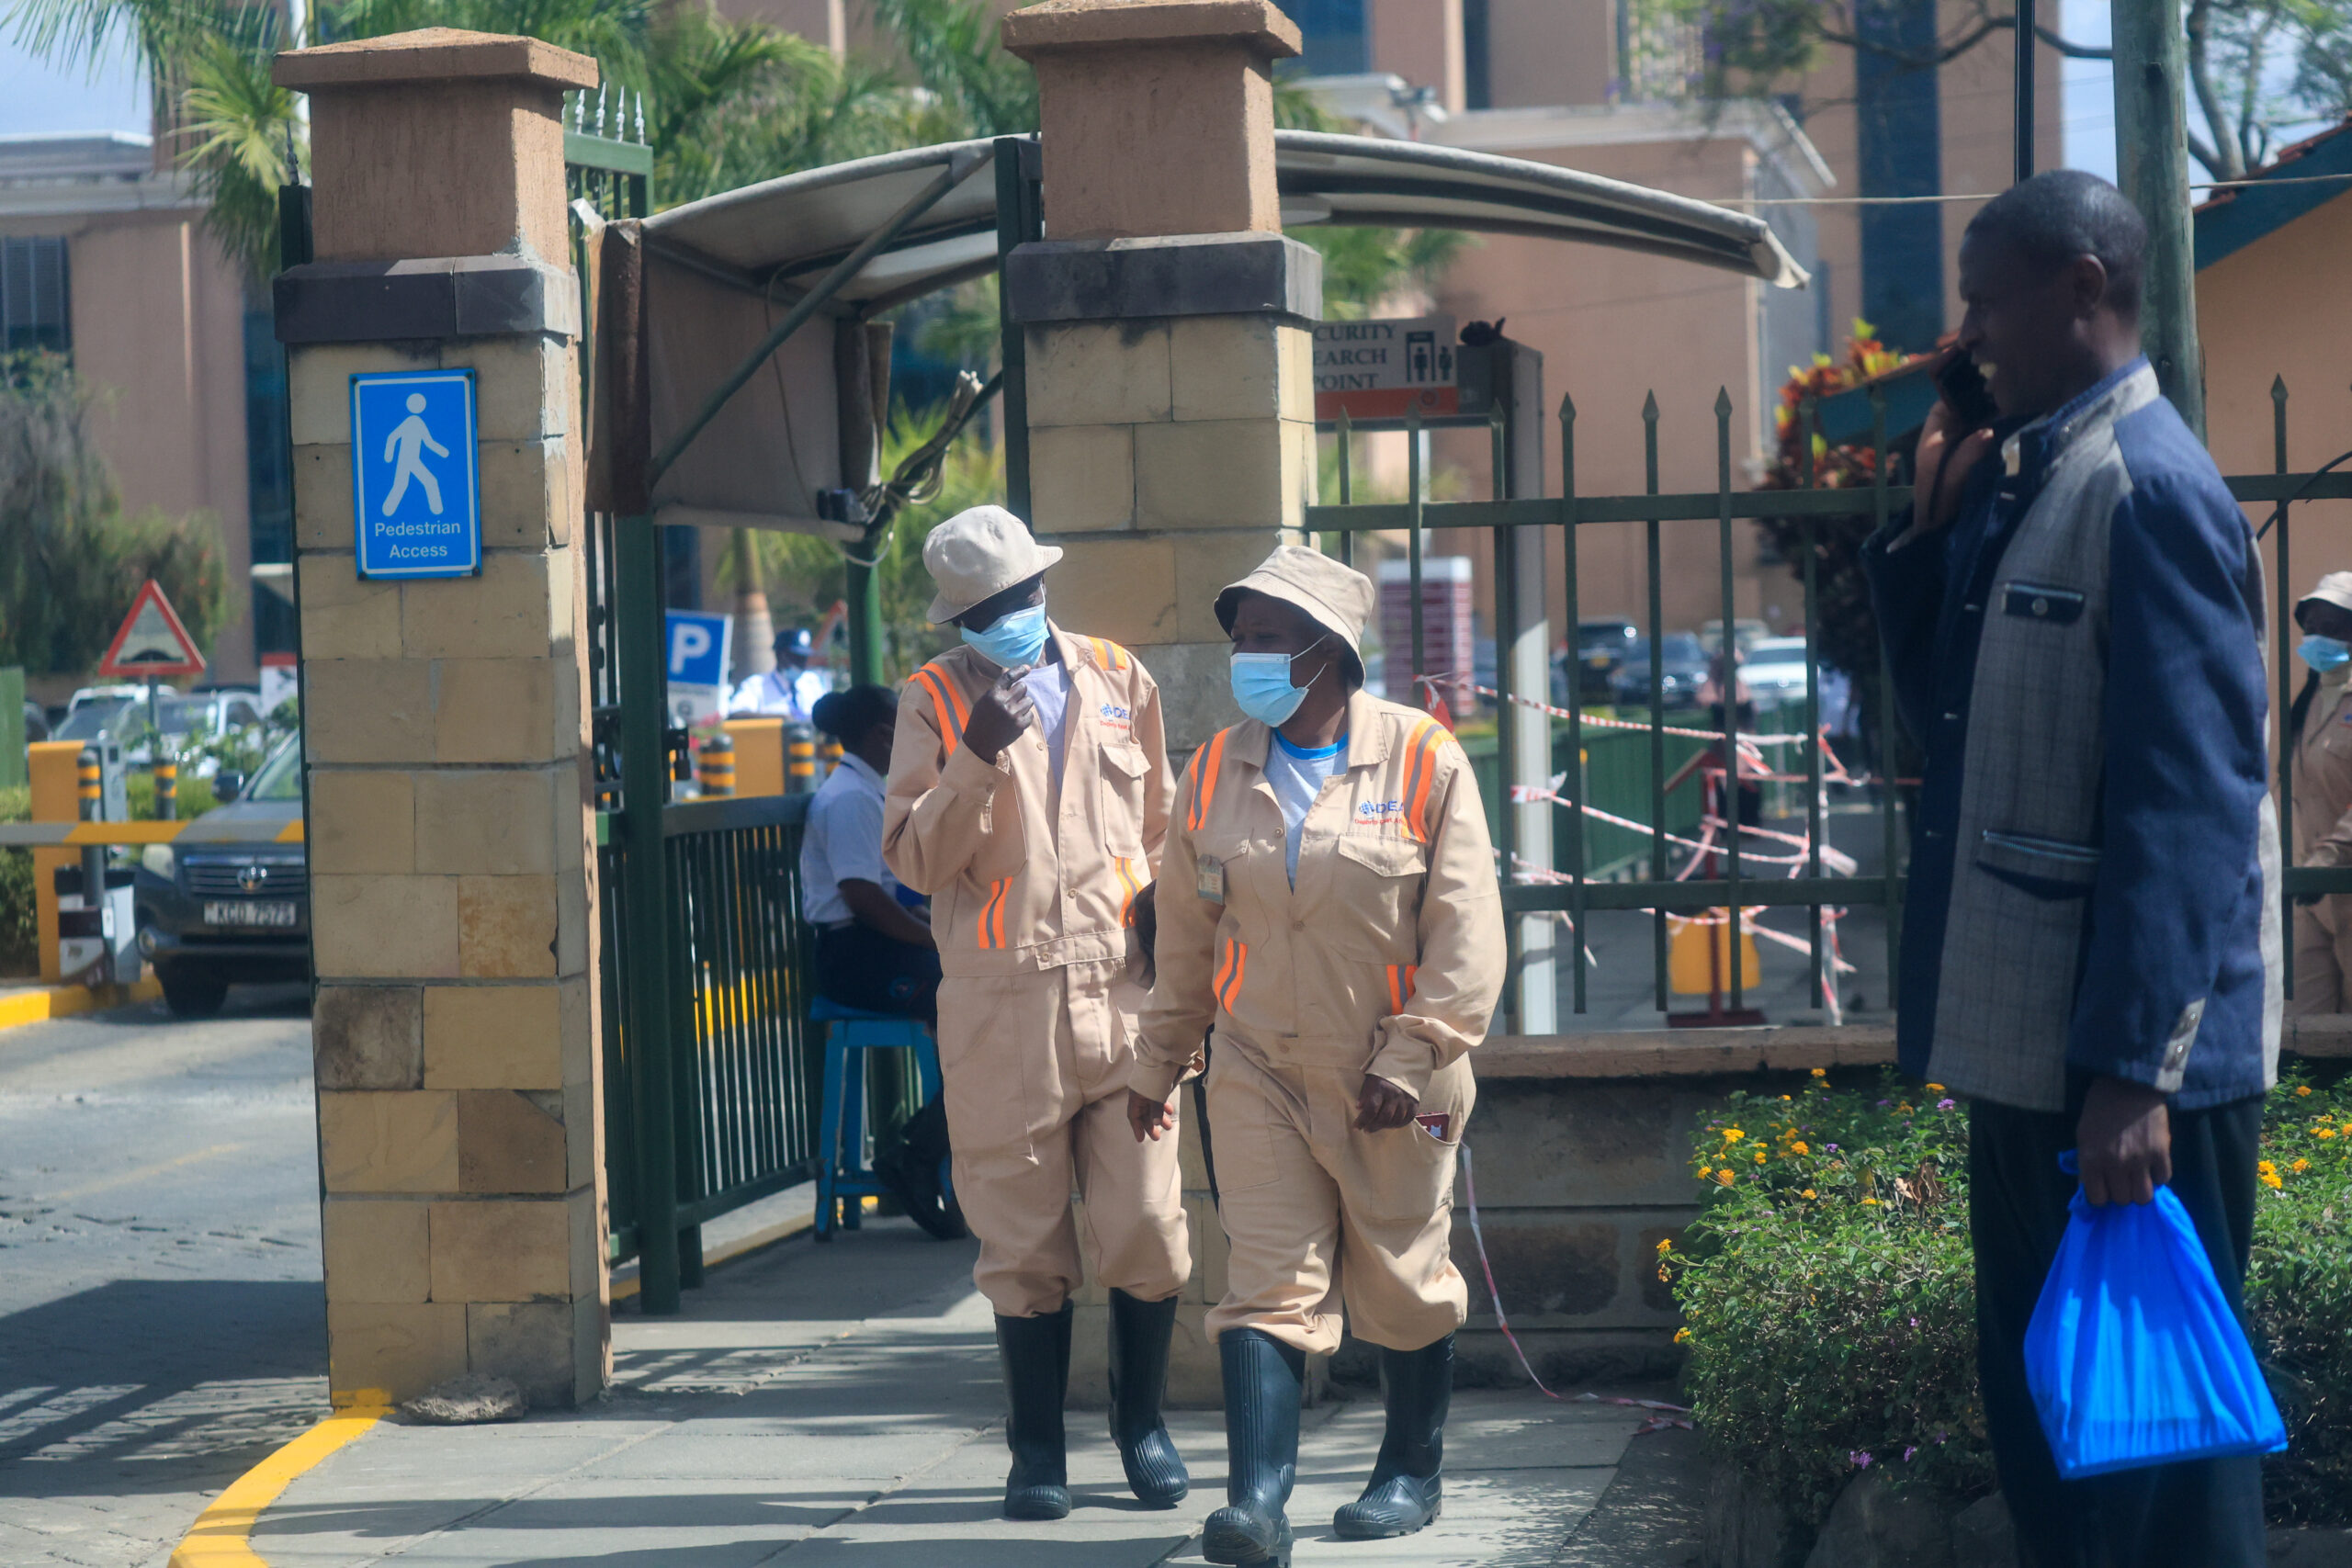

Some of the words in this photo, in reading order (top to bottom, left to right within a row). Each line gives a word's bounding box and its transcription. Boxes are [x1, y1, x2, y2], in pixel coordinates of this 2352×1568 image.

[1314, 324, 1396, 341] CURITY
[1314, 349, 1385, 366] EARCH
[375, 521, 460, 536] Pedestrian
[389, 544, 448, 558] Access
[669, 623, 712, 674] P
